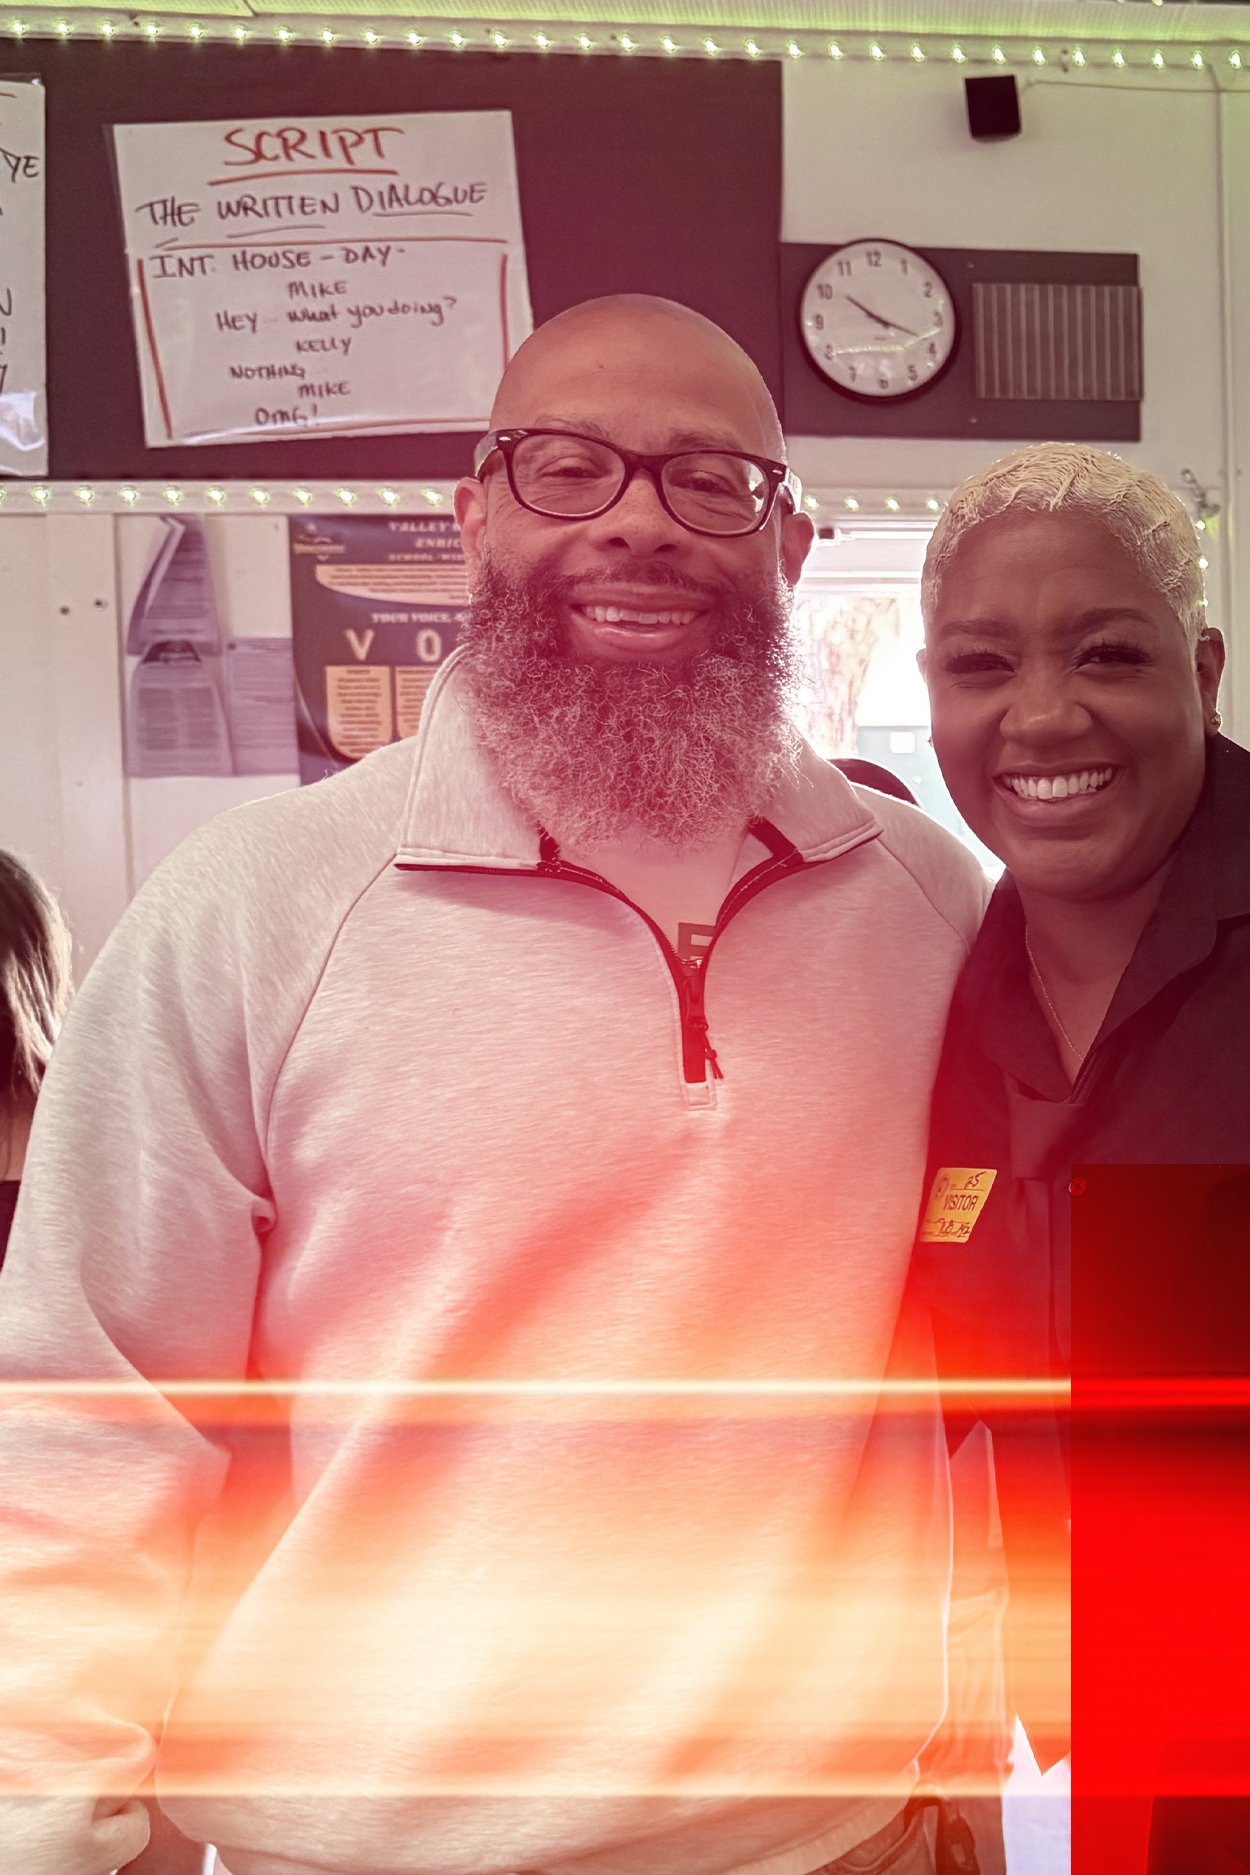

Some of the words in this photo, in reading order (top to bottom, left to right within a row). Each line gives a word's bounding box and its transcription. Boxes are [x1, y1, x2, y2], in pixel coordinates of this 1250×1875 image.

[223, 125, 406, 167] SCRIPT
[135, 195, 201, 227] THE
[217, 193, 340, 220] WRITTEN
[350, 181, 488, 214] DIALOGUE
[232, 248, 312, 271] HOUSE
[866, 250, 882, 268] 12
[901, 258, 908, 275] 1
[838, 260, 852, 277] 11
[288, 279, 348, 300] MIKE
[816, 283, 834, 300] 10
[923, 281, 934, 299] 2
[296, 336, 352, 356] KELLY
[229, 363, 306, 381] NOTHING
[907, 364, 919, 382] 5
[298, 381, 352, 399] MIKE
[388, 521, 450, 533] VALLEY
[943, 1193, 979, 1211] VISITOR
